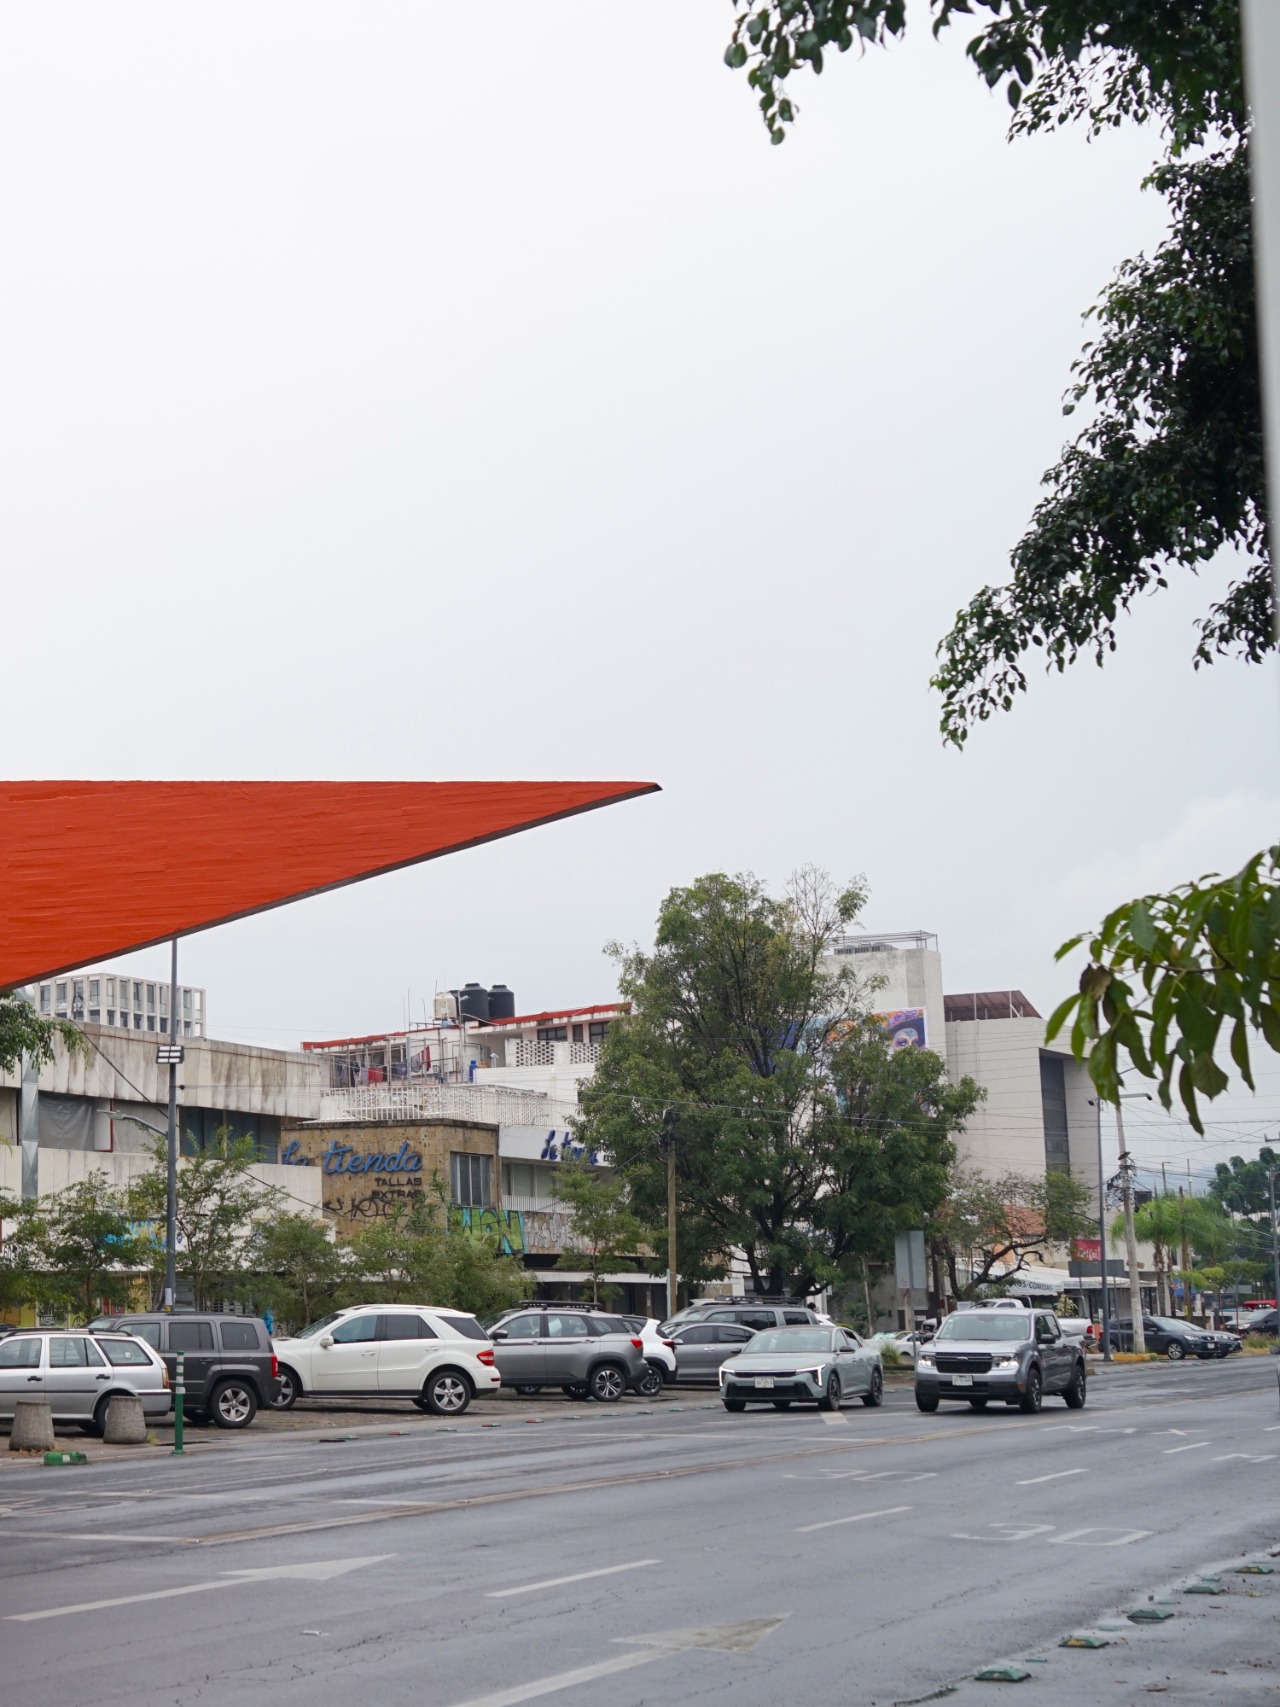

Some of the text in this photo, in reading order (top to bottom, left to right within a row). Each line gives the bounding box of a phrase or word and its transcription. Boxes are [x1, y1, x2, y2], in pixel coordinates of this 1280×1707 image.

[321, 1139, 422, 1174] tienda
[375, 1177, 423, 1187] TALLAS
[371, 1189, 423, 1200] EXTRAS
[950, 1522, 1155, 1546] 30
